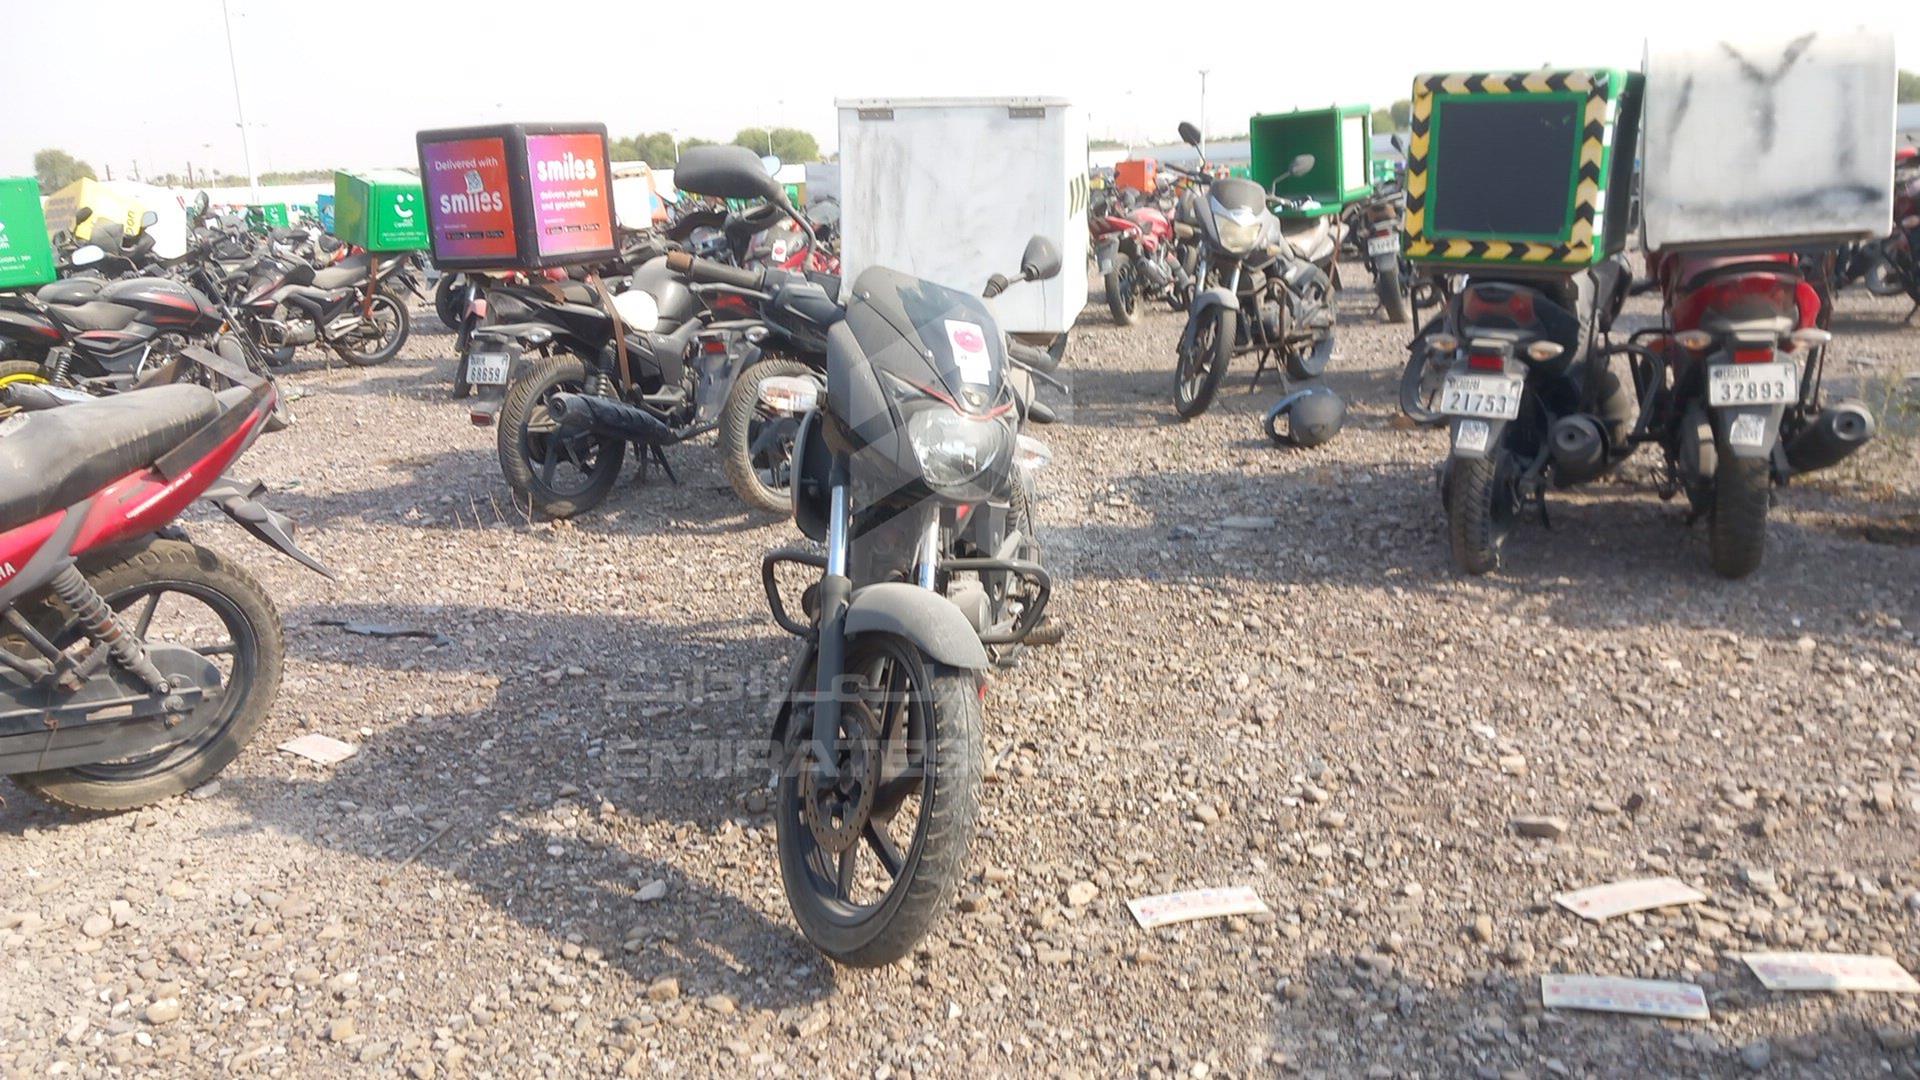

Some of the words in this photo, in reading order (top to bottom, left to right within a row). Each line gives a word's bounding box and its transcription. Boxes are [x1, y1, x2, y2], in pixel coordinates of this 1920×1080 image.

[434, 157, 477, 171] Delivered
[478, 155, 499, 168] with
[537, 151, 597, 182] smiles
[440, 190, 504, 214] smiles
[1720, 380, 1785, 401] 32893
[1451, 391, 1507, 413] 21753
